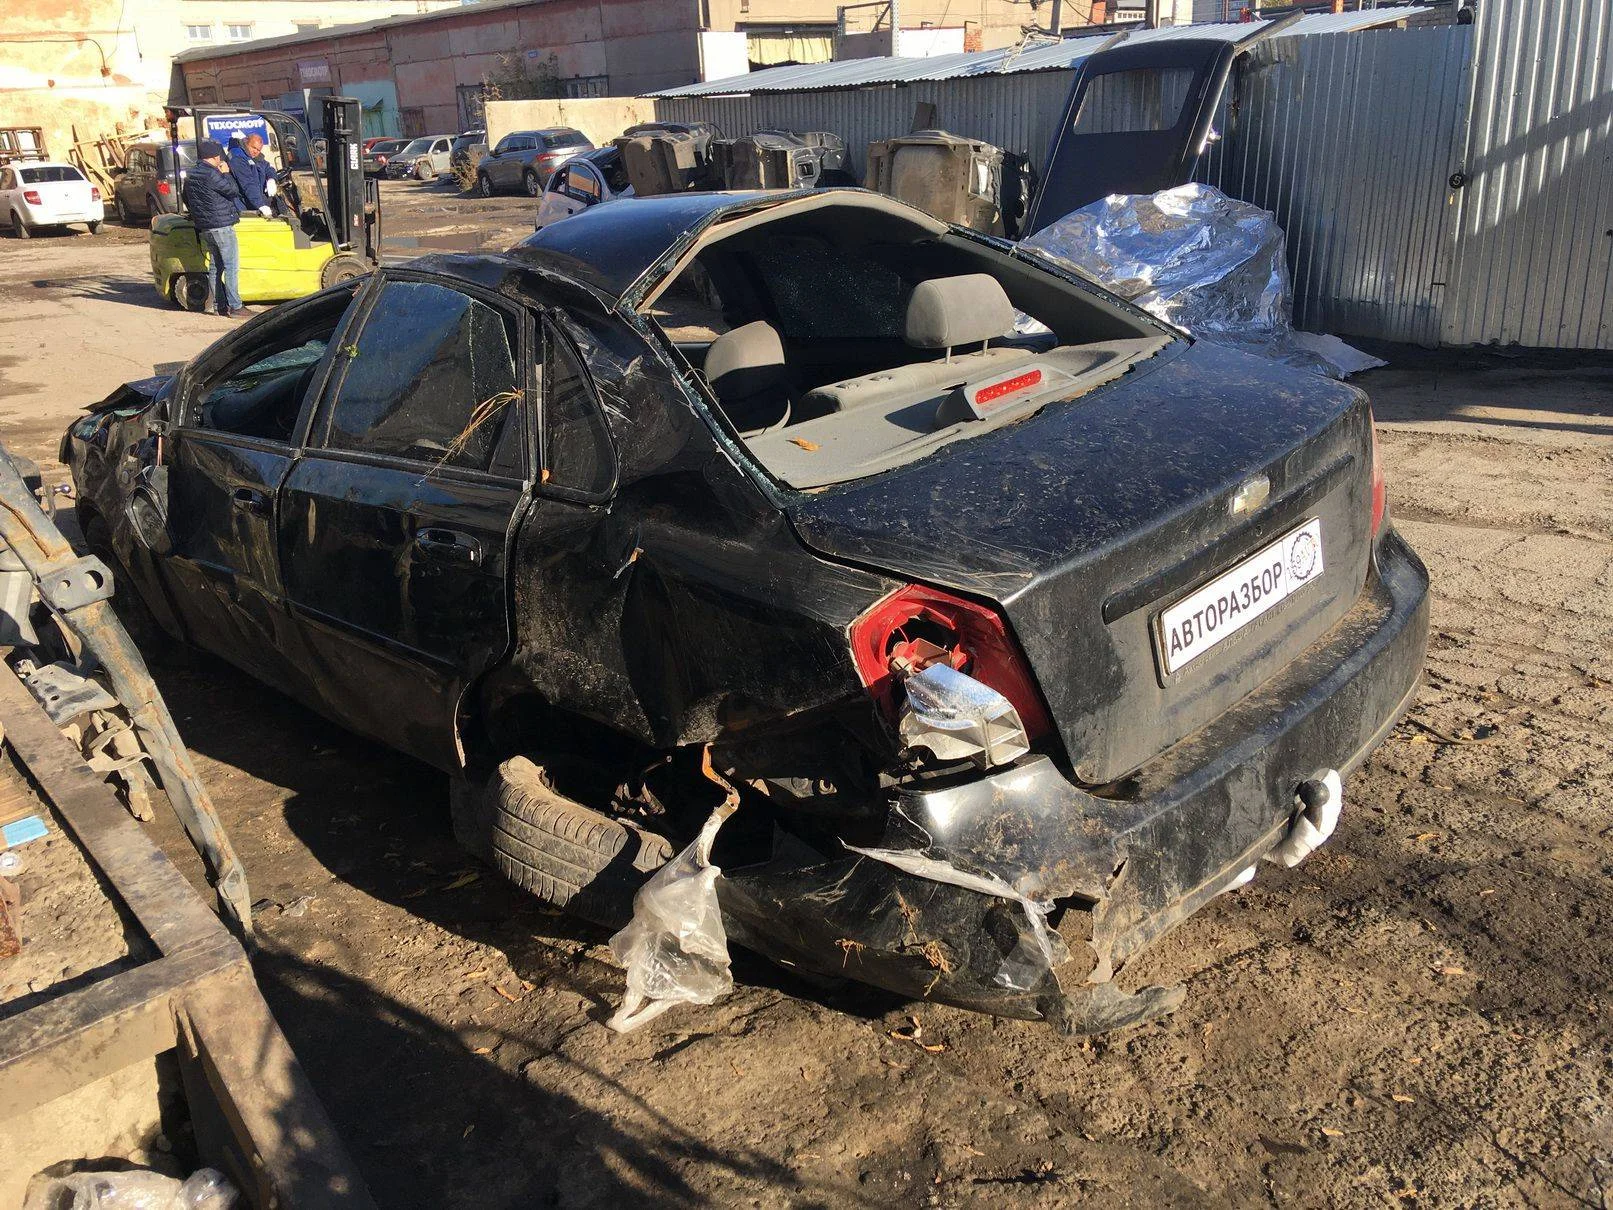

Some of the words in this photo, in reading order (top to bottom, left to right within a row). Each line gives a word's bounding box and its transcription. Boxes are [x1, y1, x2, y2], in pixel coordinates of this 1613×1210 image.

[209, 119, 264, 130] ТЕХОСМОТР
[350, 143, 359, 170] CLARK
[1170, 561, 1283, 658] АВТОРАЗБОР
